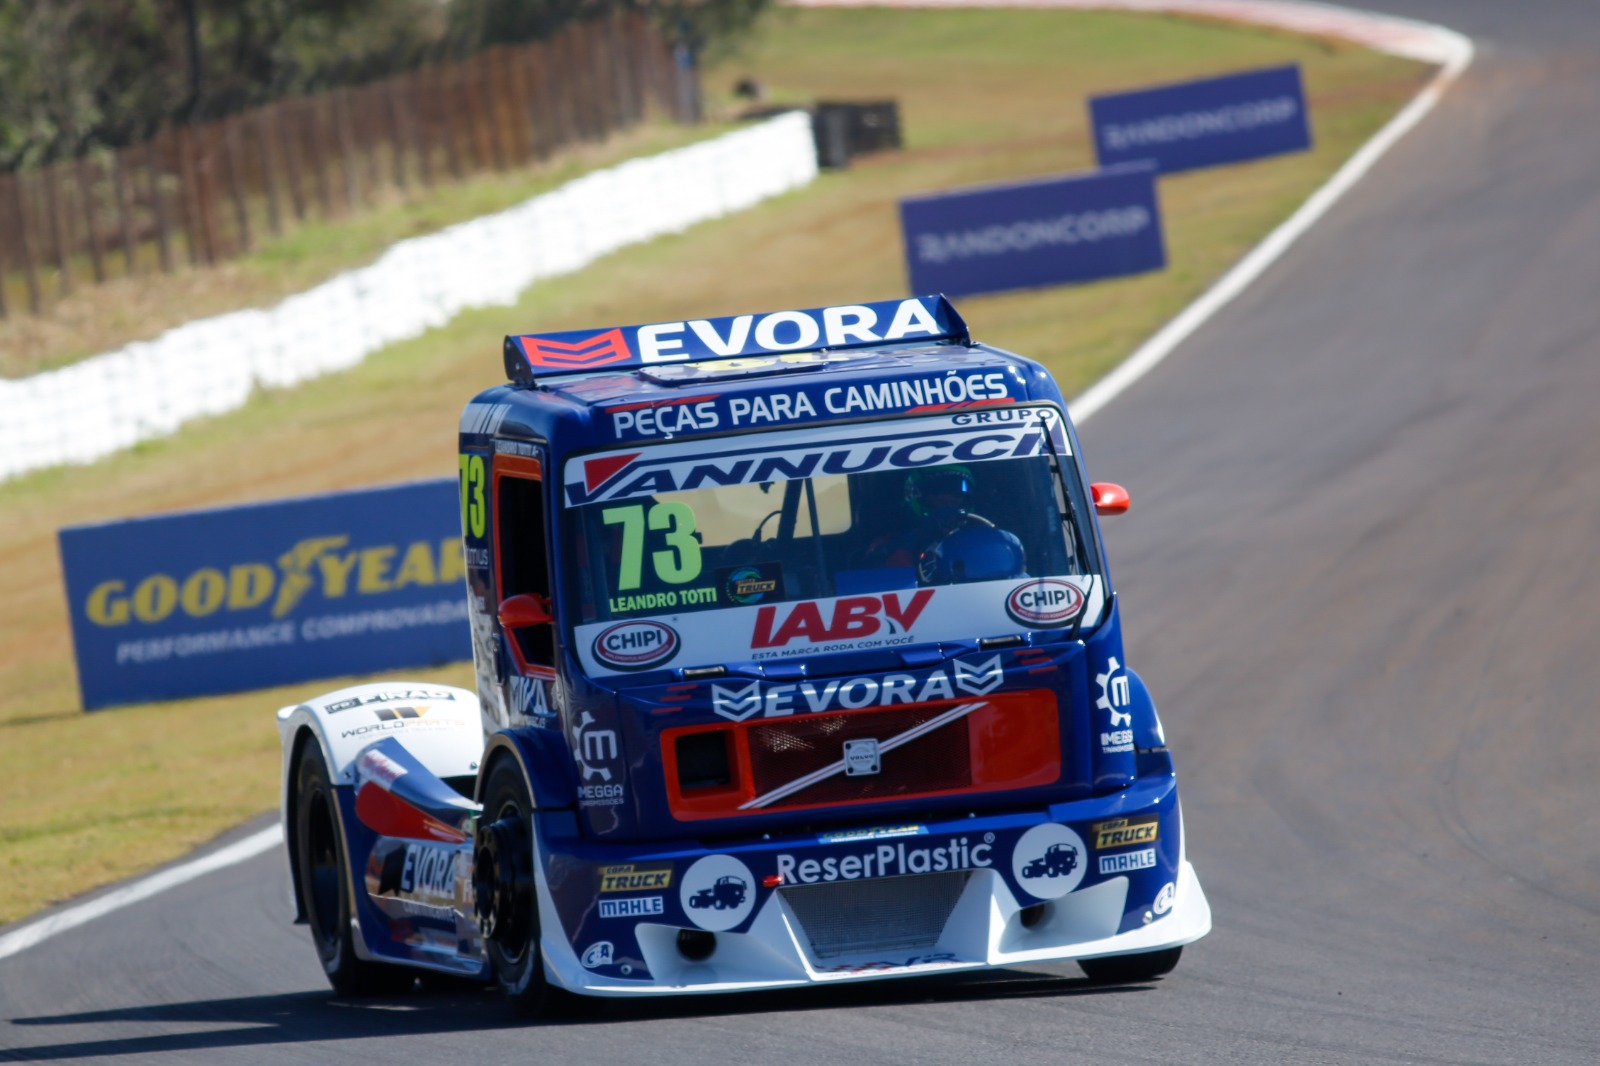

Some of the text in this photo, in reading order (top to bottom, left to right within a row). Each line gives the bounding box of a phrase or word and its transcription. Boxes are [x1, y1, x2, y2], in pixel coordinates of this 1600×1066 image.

[637, 298, 942, 363] EVORA
[613, 369, 1008, 439] PEÇAS PARA CAMINHÕES
[952, 408, 1054, 426] GRUPO
[459, 453, 485, 539] 73
[602, 501, 702, 591] 73
[739, 581, 773, 593] TRUCK
[1020, 589, 1071, 608] CHIPI
[609, 587, 718, 613] LEANDRO TOTTI
[116, 621, 296, 665] PERFORMANCE
[606, 629, 662, 651] CHIPI
[752, 635, 915, 660] ESTA MARCA RODA COM VOCÊ
[764, 669, 956, 718] EVORA
[577, 784, 623, 798] MEGGA
[1100, 826, 1154, 845] TRUCK
[401, 843, 456, 900] EVORA
[1102, 851, 1154, 871] MAHLE
[605, 872, 669, 889] TRUCK
[601, 898, 662, 916] MAHLE
